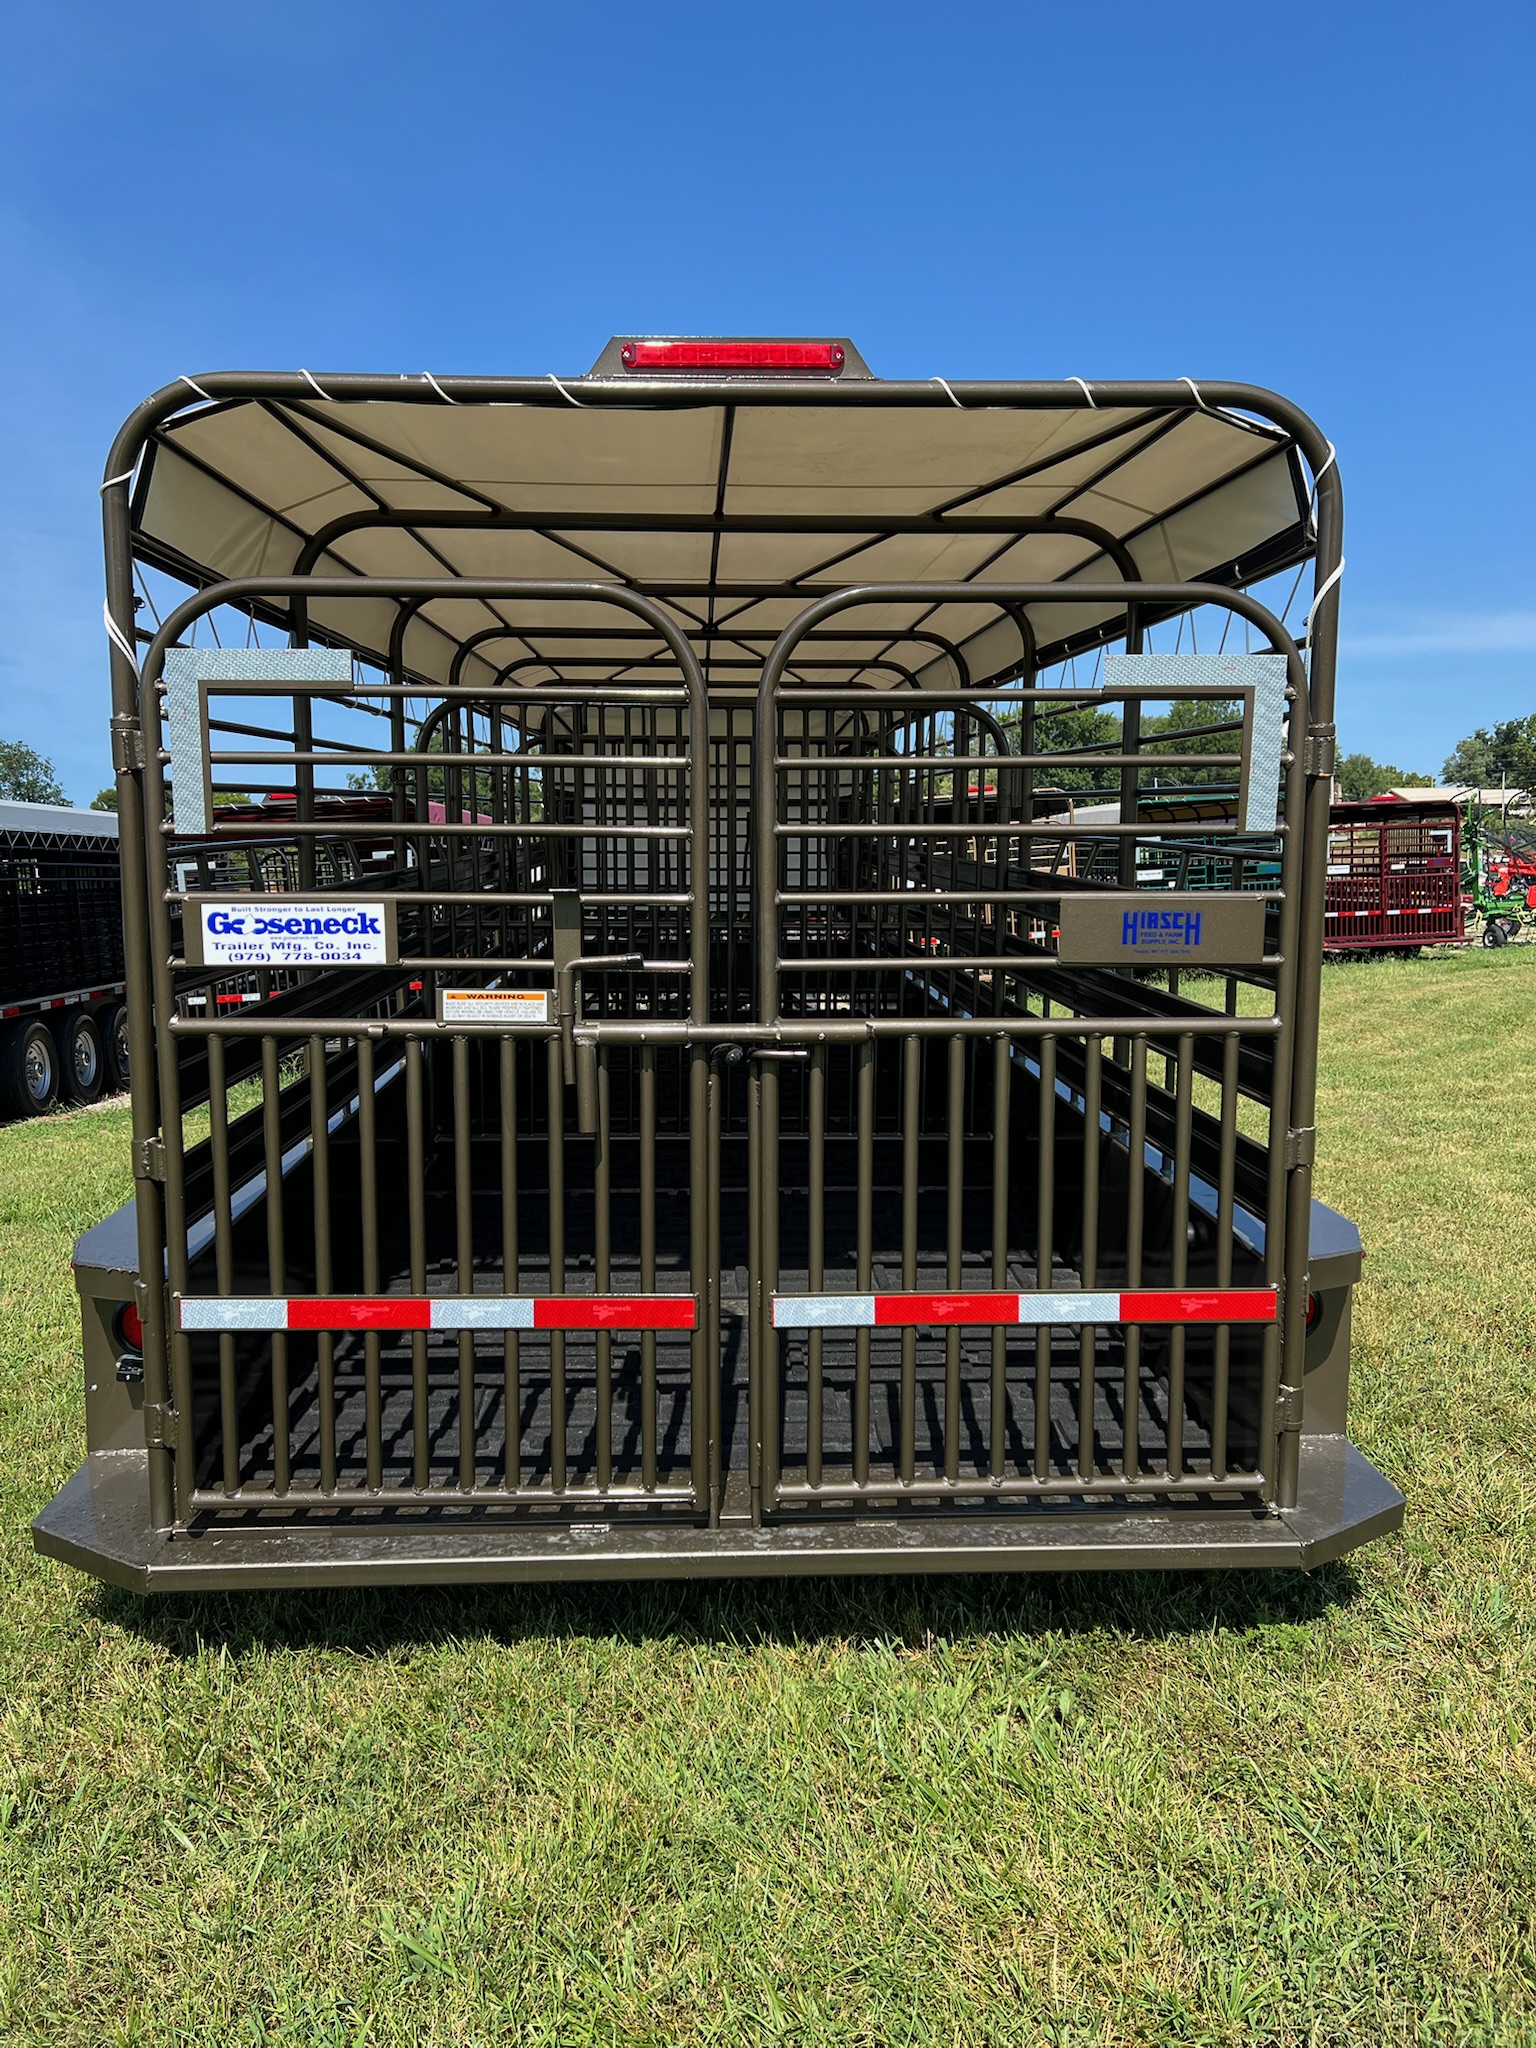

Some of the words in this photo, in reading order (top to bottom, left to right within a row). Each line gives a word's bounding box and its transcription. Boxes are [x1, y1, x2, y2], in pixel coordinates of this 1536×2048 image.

[207, 912, 381, 935] Gooseneck
[1122, 911, 1201, 945] HIRSCH
[212, 942, 264, 950] Trailer
[271, 942, 308, 951] Mfg.
[314, 942, 340, 950] Co.
[347, 942, 378, 950] Inc.
[228, 952, 270, 962] (979)
